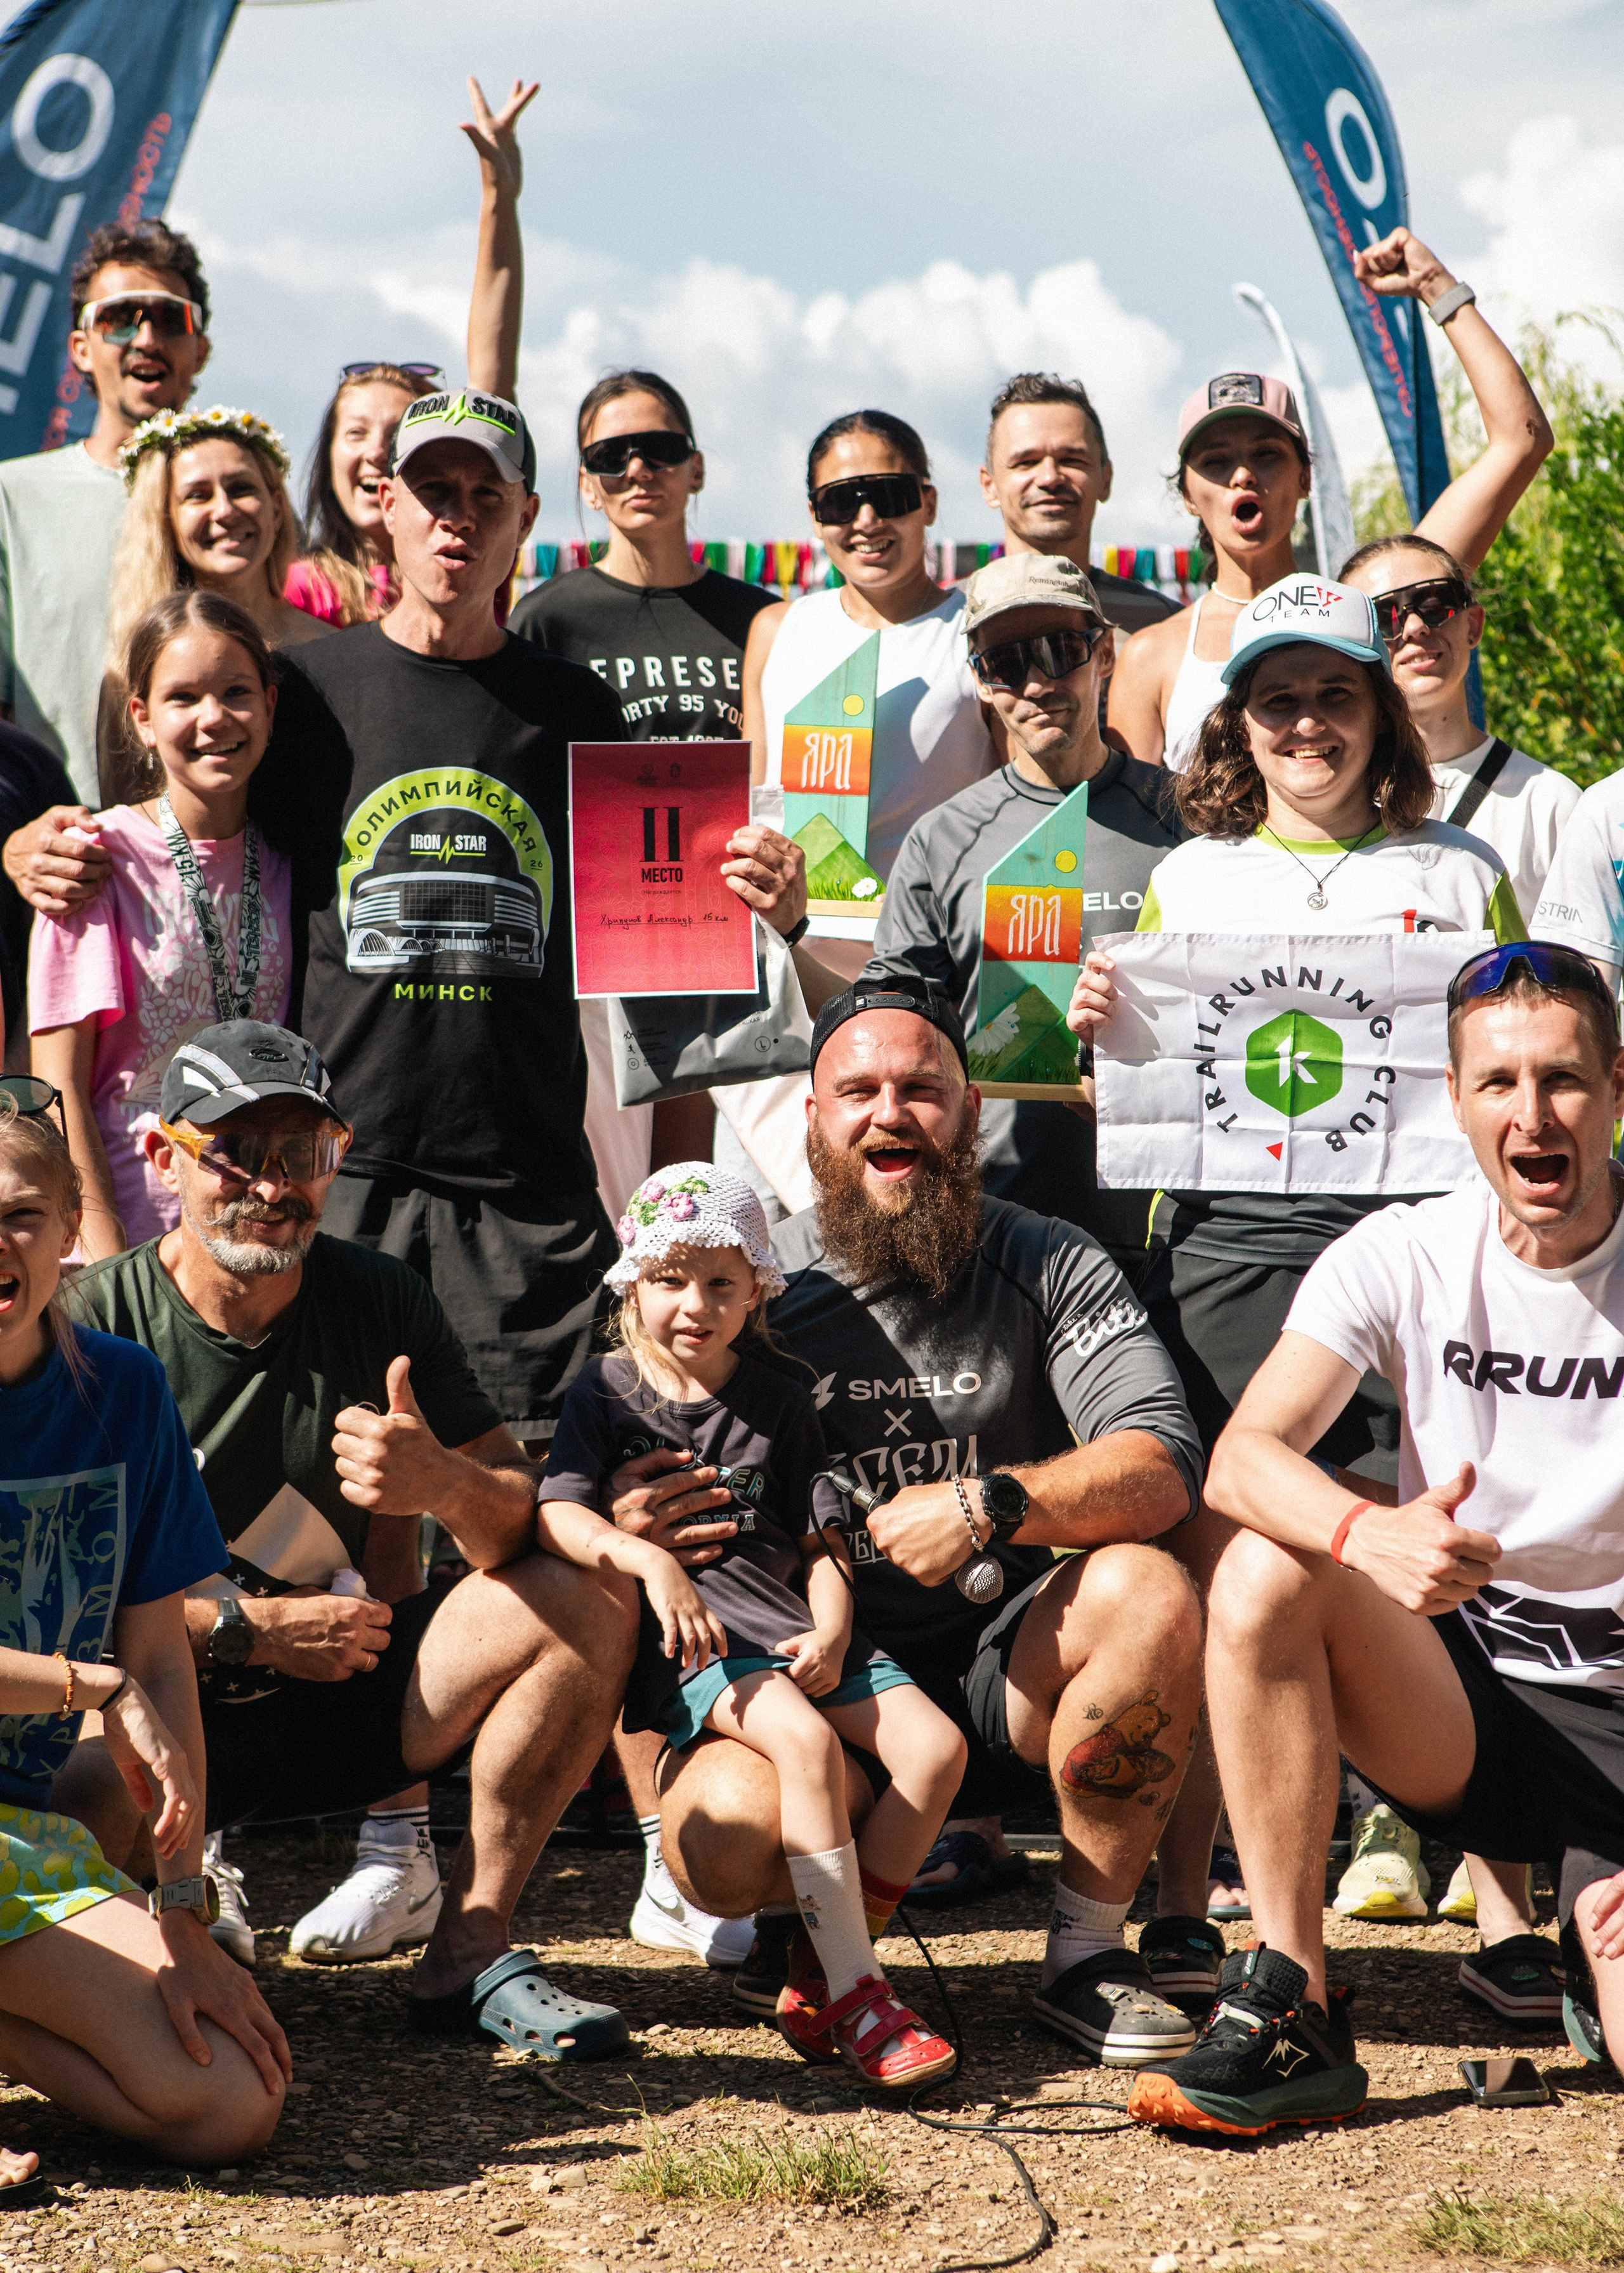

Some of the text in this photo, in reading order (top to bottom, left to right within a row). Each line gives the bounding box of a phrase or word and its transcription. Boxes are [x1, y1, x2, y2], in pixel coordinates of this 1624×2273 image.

[408, 395, 450, 420] IRON
[1028, 576, 1070, 588] Remington
[1253, 586, 1319, 621] ONE
[1269, 608, 1330, 623] TEAM
[678, 694, 705, 713] 95
[801, 731, 853, 790] ЯРА
[357, 779, 537, 853] ОЛИМПИЙСКАЯ
[410, 834, 487, 852] IRON STAR
[639, 807, 684, 862] II
[641, 867, 683, 883] МЕСТО
[1007, 893, 1062, 956] ЯРА
[394, 983, 494, 1003] МИНСК
[1325, 1065, 1396, 1152] CLUB
[848, 1371, 982, 1401] SMELO
